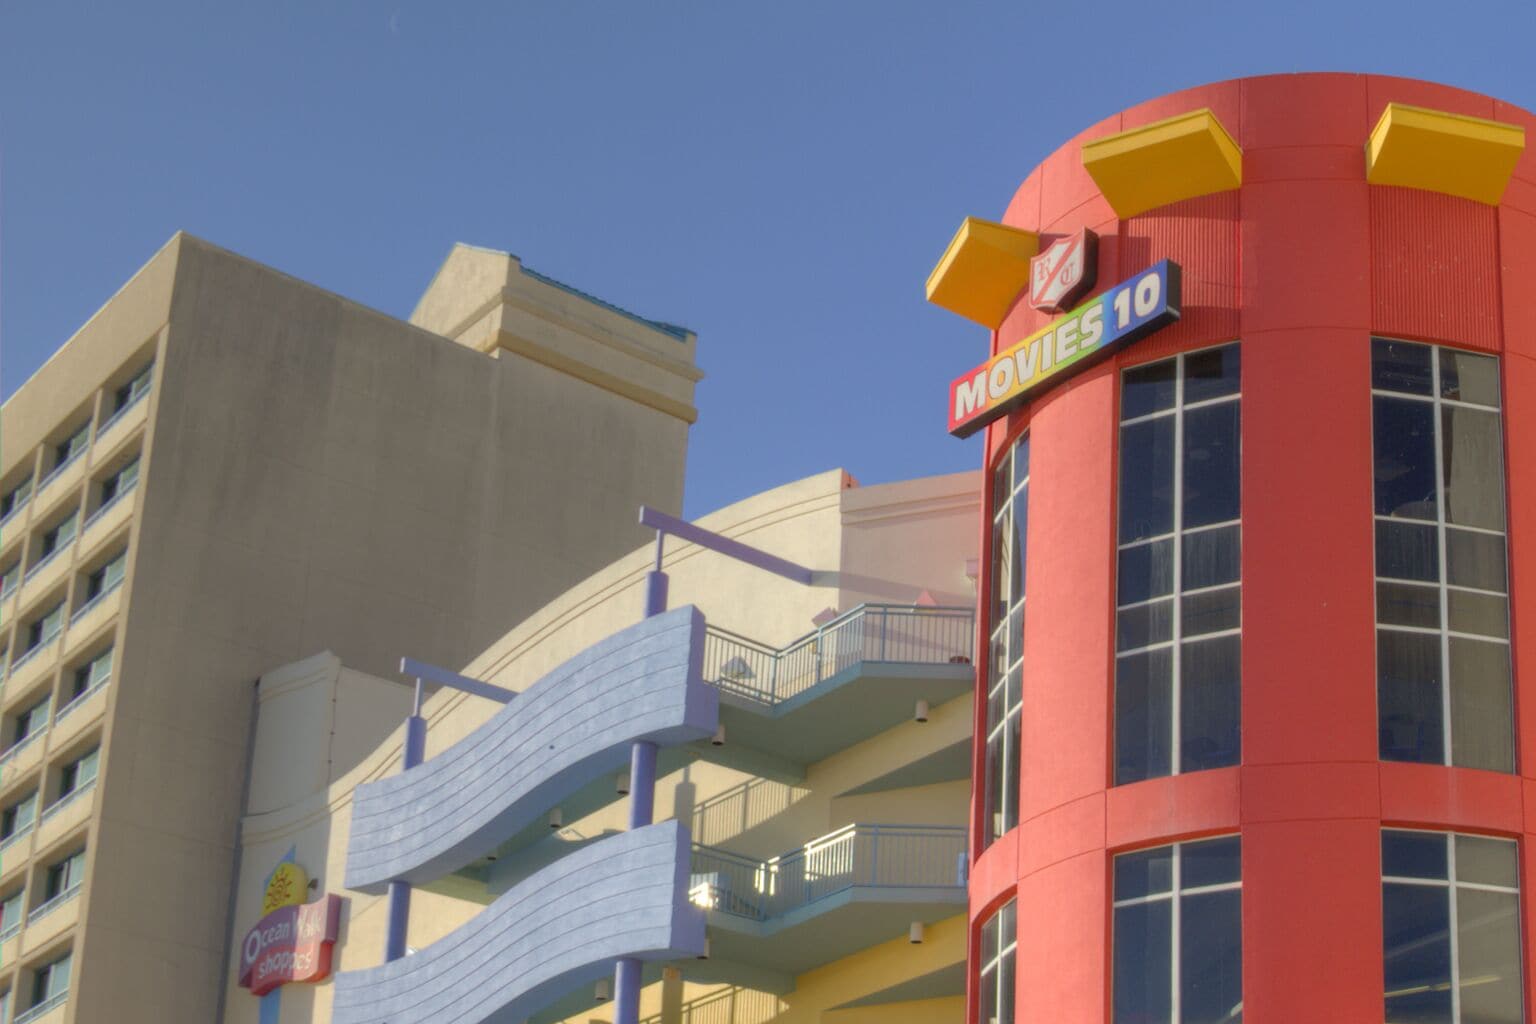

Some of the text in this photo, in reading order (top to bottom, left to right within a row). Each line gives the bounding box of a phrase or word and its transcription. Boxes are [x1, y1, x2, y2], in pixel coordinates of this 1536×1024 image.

[954, 271, 1161, 421] MOVIES 10
[245, 909, 321, 964] Ocean Walk
[258, 951, 312, 979] shoppes
